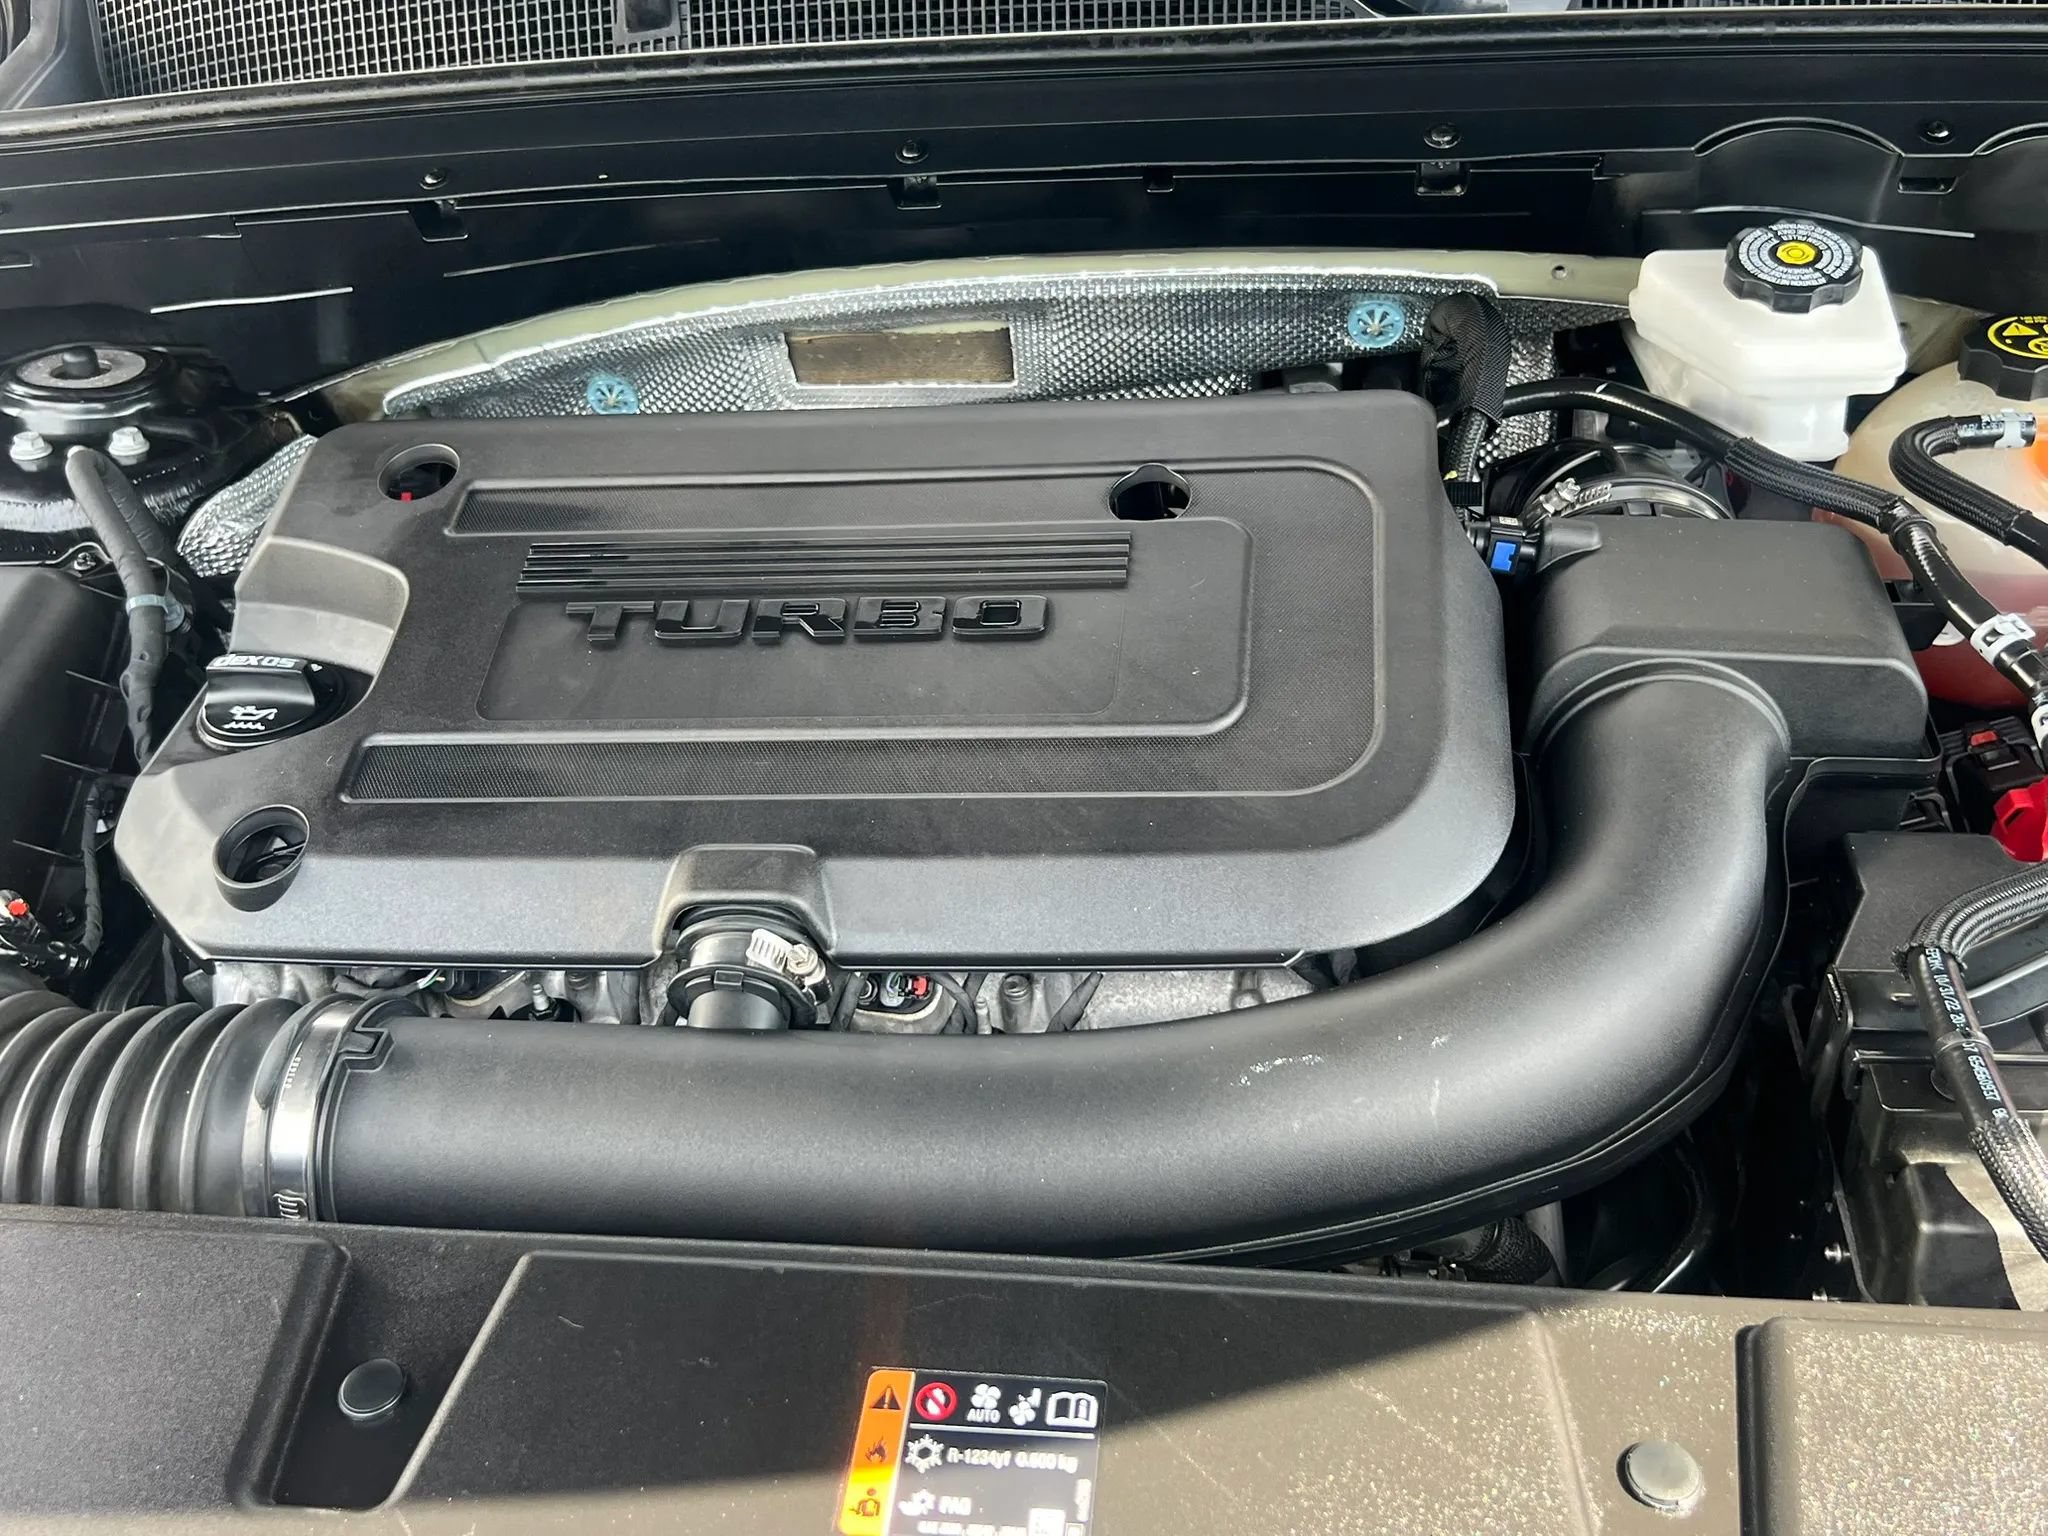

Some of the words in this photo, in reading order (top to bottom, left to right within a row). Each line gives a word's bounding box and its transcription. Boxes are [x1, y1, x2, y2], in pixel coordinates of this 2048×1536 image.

[566, 595, 1049, 641] TURBO
[213, 653, 300, 668] dexos
[1934, 974, 1961, 1012] 10/31/22
[966, 1407, 1001, 1424] AUTO
[947, 1446, 1012, 1470] R-1234yf
